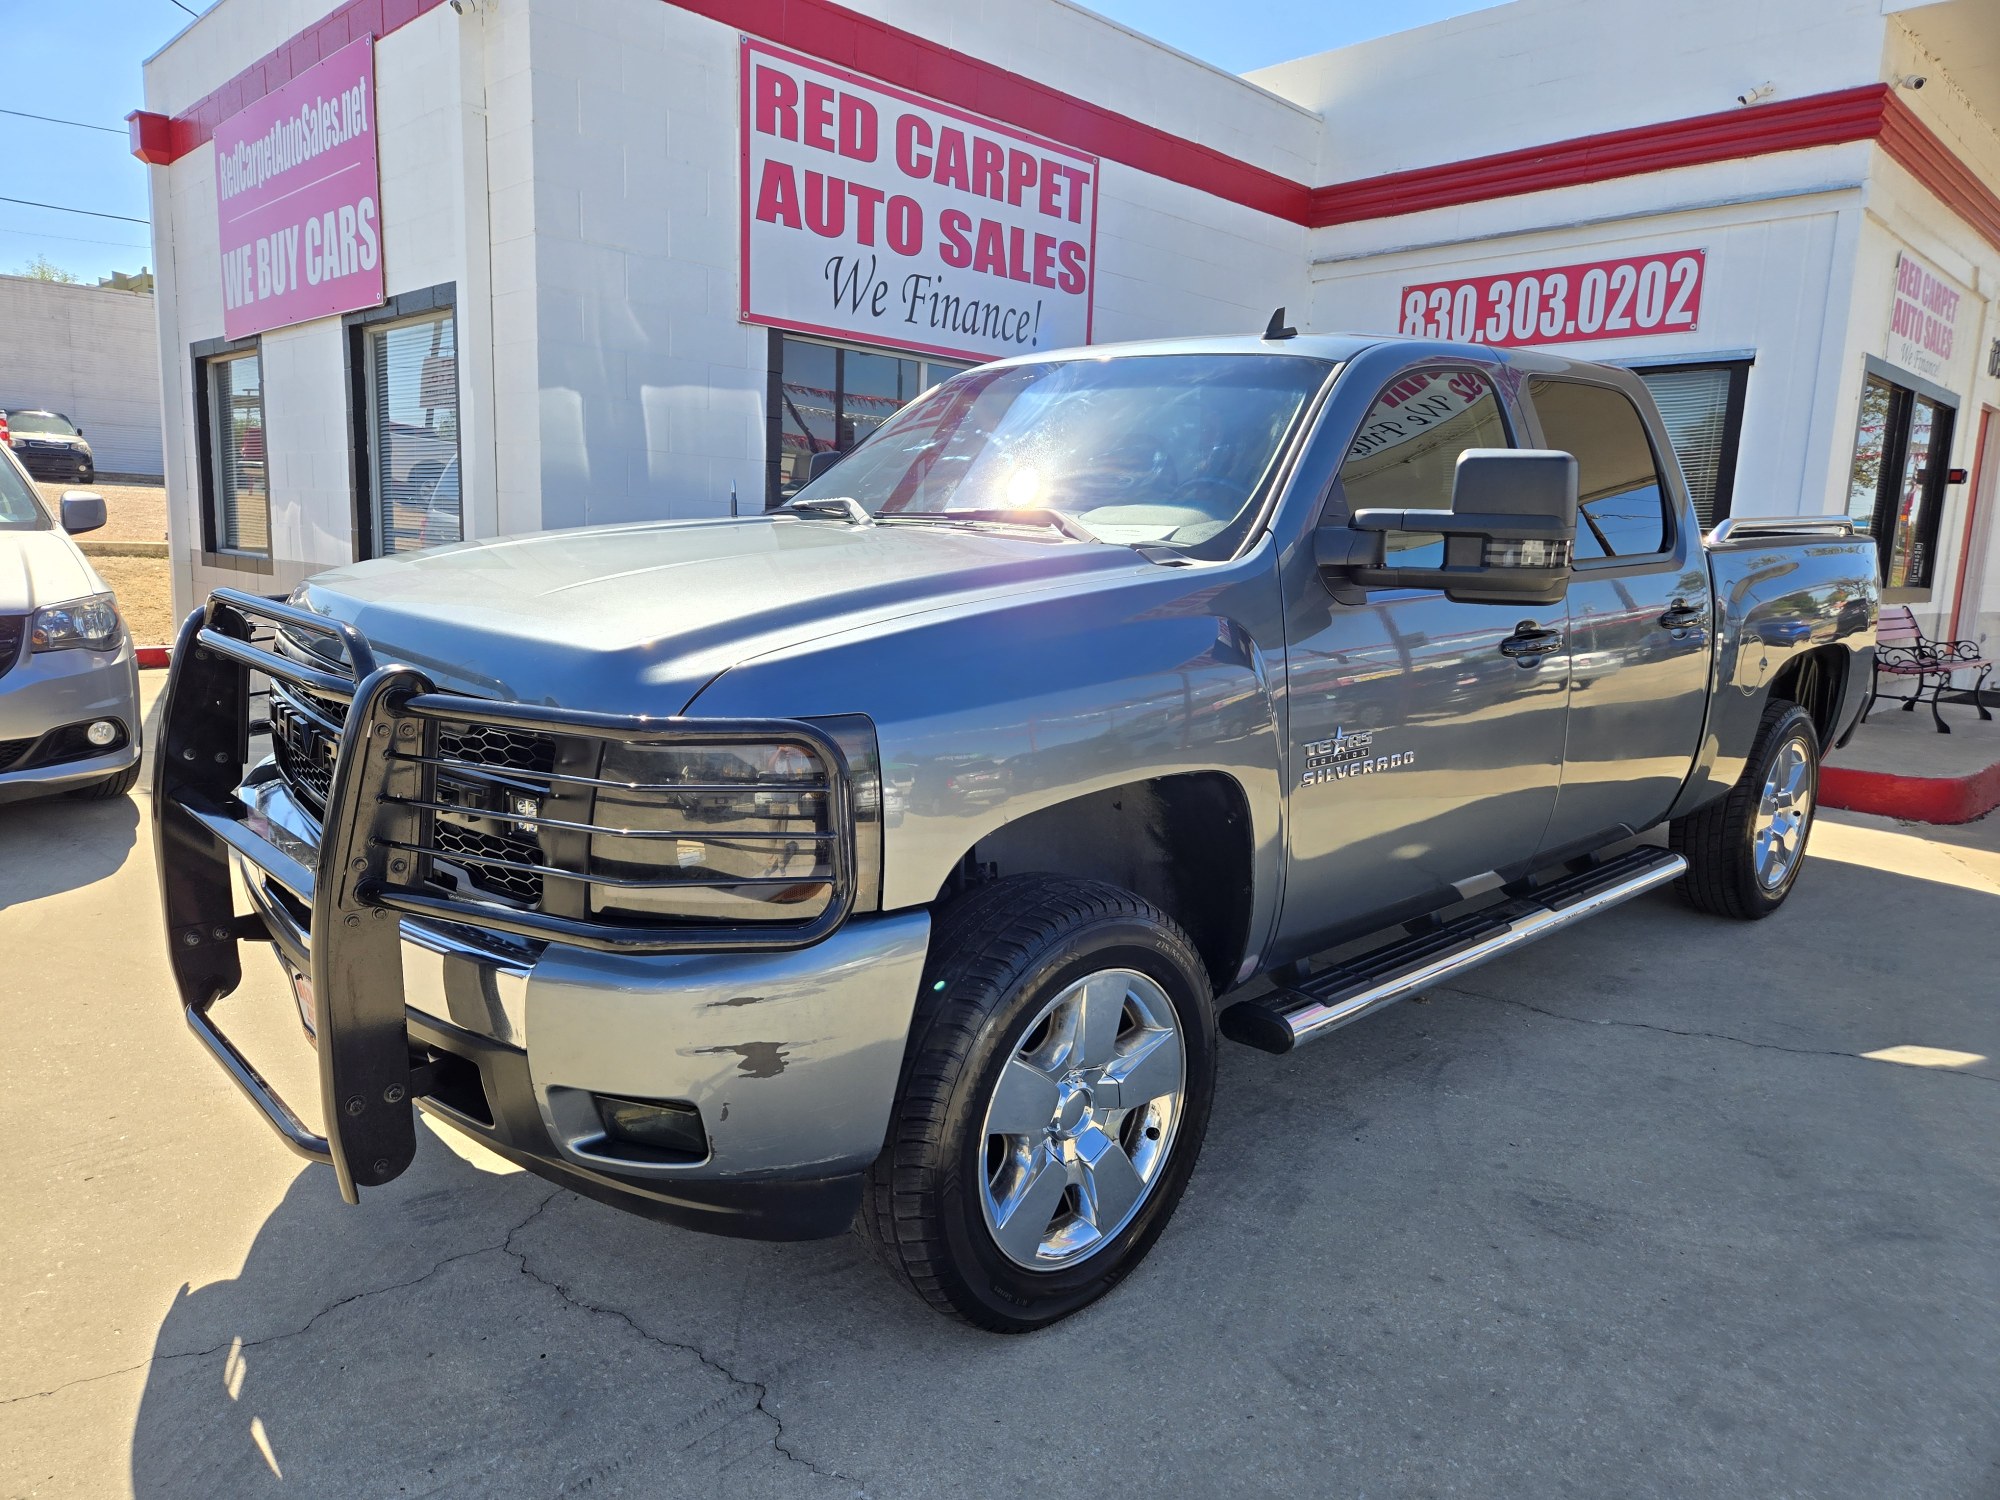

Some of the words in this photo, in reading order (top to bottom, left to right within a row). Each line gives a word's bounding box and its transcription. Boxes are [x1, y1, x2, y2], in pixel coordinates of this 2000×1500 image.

[219, 76, 368, 201] RedCarpetAutoSales.net
[756, 64, 878, 163] RED
[896, 113, 1090, 225] CARPET
[222, 244, 254, 311] WE
[256, 224, 299, 301] BUY
[305, 196, 378, 286] CARS
[756, 158, 923, 257] AUTO
[939, 208, 1087, 295] SALES
[825, 254, 888, 318] We
[902, 273, 1042, 348] Finance!
[1402, 256, 1699, 344] 830.303.0202
[1891, 297, 1924, 345] AUTO
[1923, 315, 1953, 361] SALES
[1897, 257, 1922, 300] RED
[1922, 273, 1960, 324] CARPET
[1901, 342, 1914, 366] We
[1301, 750, 1414, 788] SILVERADO
[1303, 727, 1373, 757] TEXAS
[1311, 751, 1367, 767] EDITION
